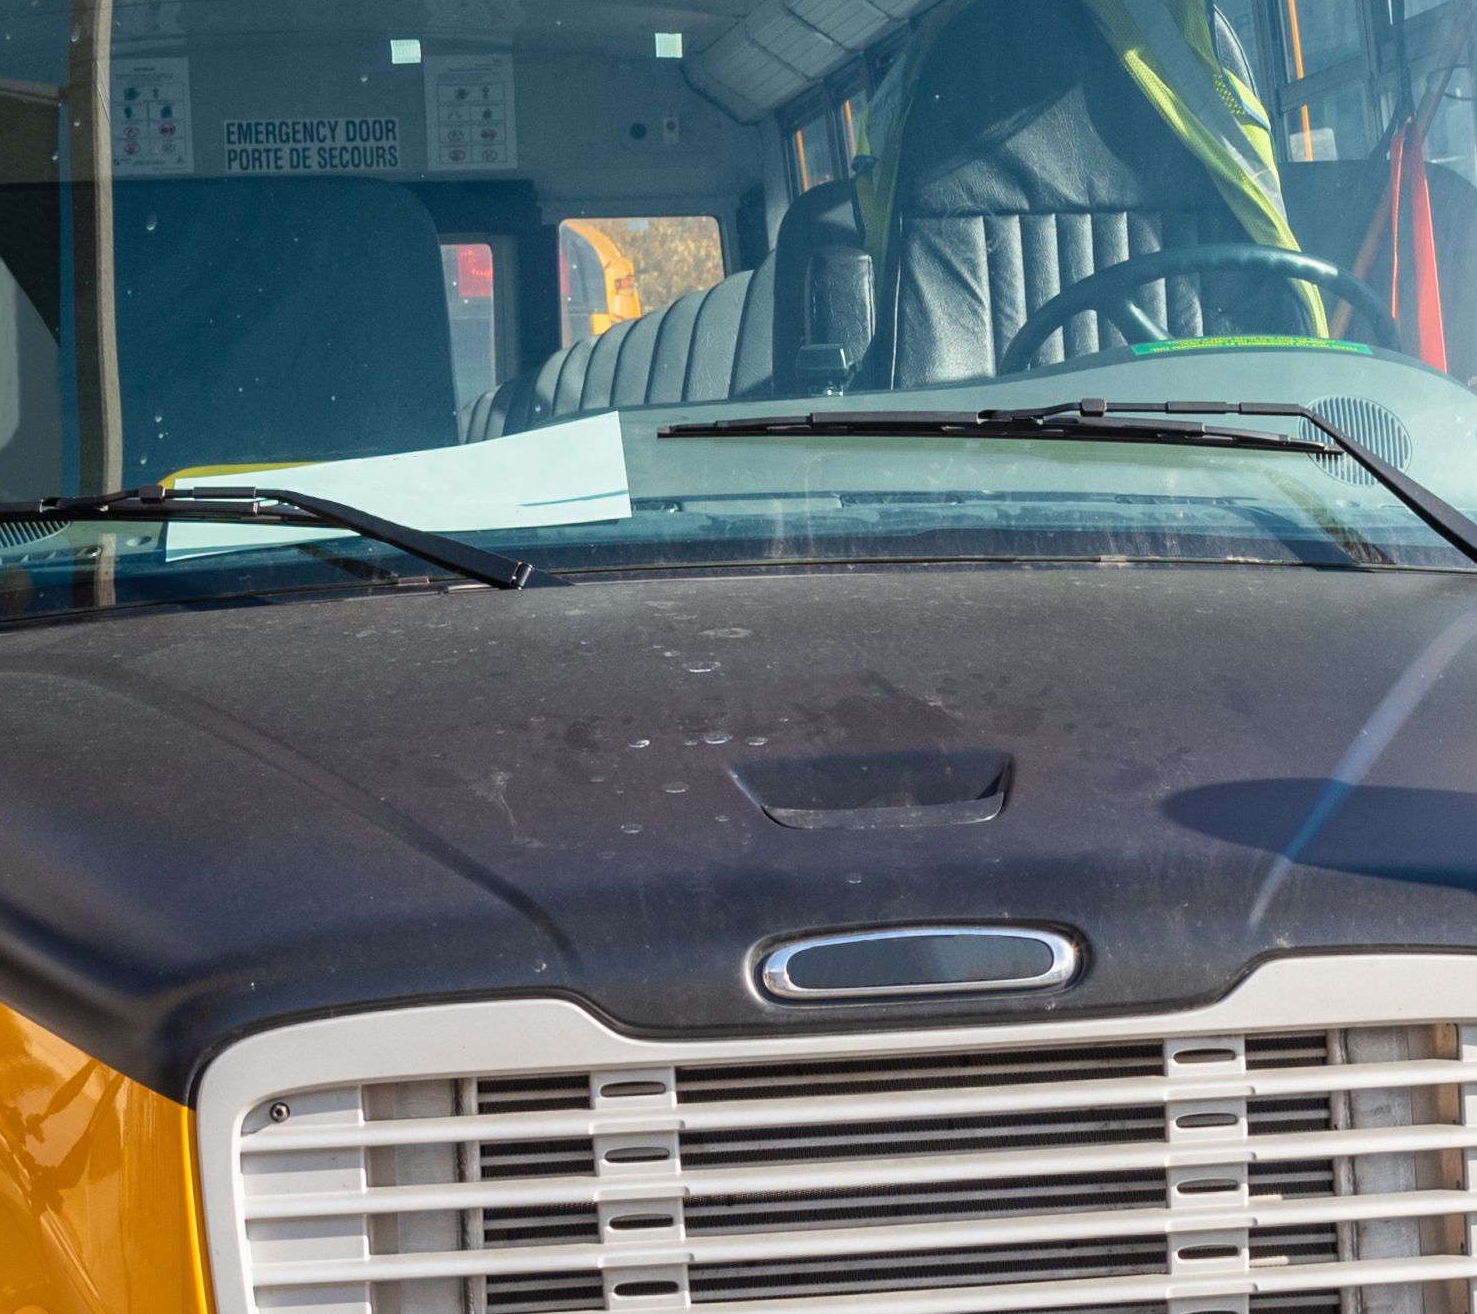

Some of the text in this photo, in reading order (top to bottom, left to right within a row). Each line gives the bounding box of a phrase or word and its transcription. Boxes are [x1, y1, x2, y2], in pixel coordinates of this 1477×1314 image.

[226, 119, 397, 145] EMERGENCY DOOR
[227, 145, 398, 171] PORTE DE SECOURS
